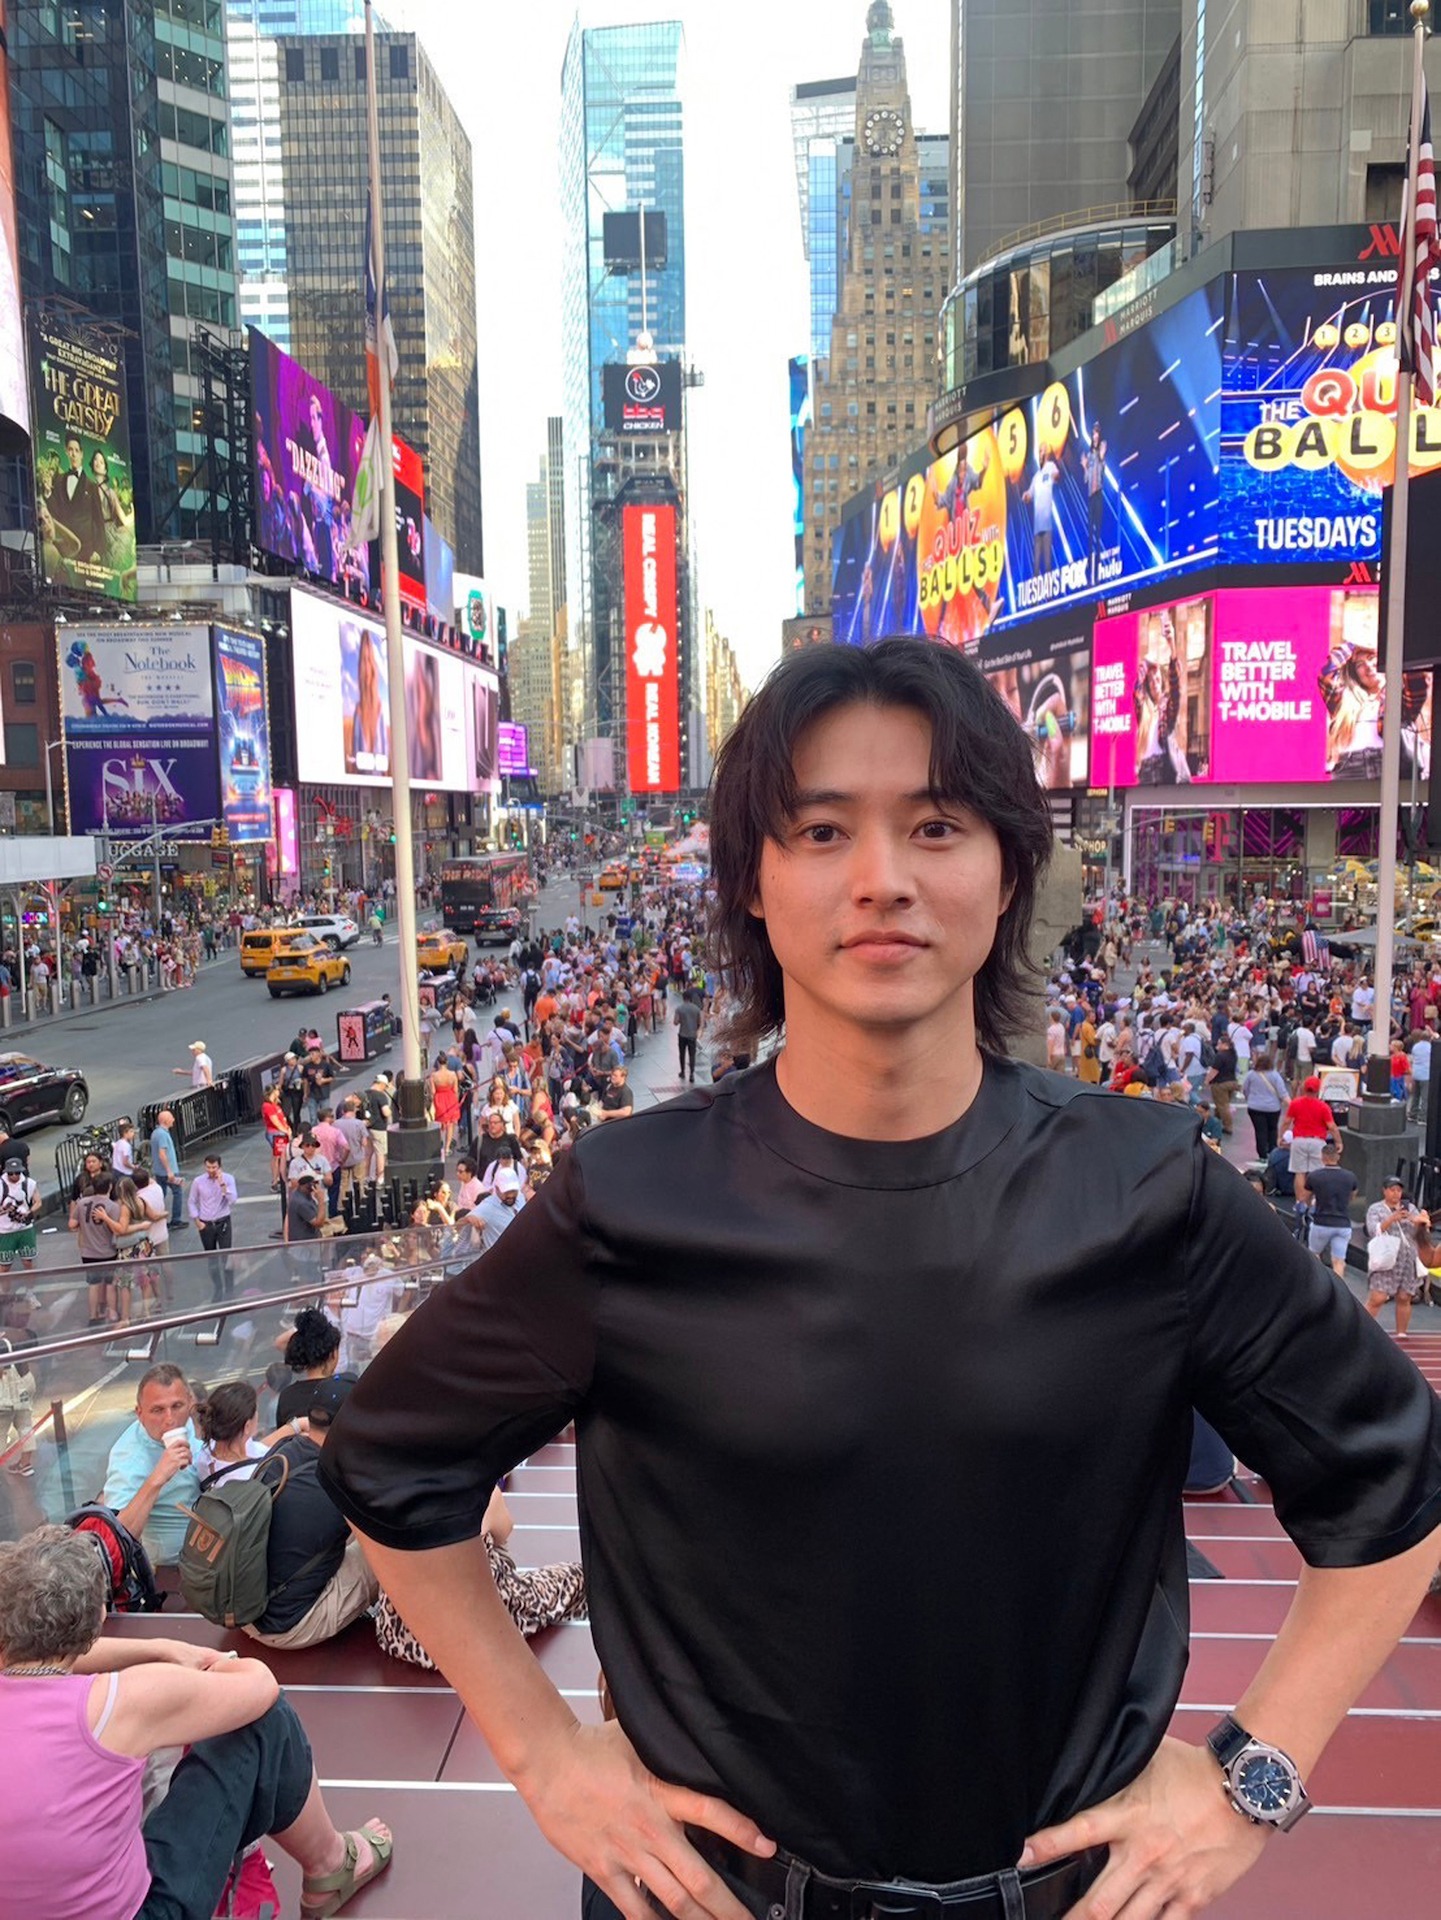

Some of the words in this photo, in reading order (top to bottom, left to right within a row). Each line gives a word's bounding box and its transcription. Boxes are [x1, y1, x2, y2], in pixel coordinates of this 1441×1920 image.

[1314, 271, 1365, 286] BRAINS
[1367, 269, 1398, 284] AND
[1120, 287, 1158, 321] MARRIOTT
[1119, 305, 1153, 335] MARQUIS
[43, 361, 70, 398] THE
[73, 379, 120, 416] GREAT
[54, 395, 114, 436] GATSBY
[1052, 395, 1061, 429] 6
[1259, 401, 1300, 421] THE
[623, 421, 663, 430] CHICKEN
[1009, 422, 1017, 455] 5
[910, 485, 917, 513] 2
[884, 503, 889, 529] 1
[933, 507, 981, 564] QUIZ
[1255, 514, 1377, 550] TUESDAYS
[920, 544, 998, 603] BALLS!
[1097, 558, 1122, 581] hulu
[1017, 568, 1060, 608] TUESDAYS
[1061, 557, 1088, 594] FOX
[123, 652, 196, 671] Notebook
[149, 646, 170, 655] The
[1221, 641, 1297, 662] TRAVEL
[1094, 662, 1125, 684] TRAVEL
[1221, 661, 1297, 682] BETTER
[1094, 680, 1125, 700] BETTER
[1220, 681, 1275, 701] WITH
[1094, 698, 1117, 717] WITH
[1219, 701, 1312, 721] T-MOBILE
[1093, 714, 1132, 734] T-MOBILE
[72, 740, 102, 749] EXPERIENCE
[103, 740, 113, 749] THE
[113, 740, 132, 749] GLOBAL
[133, 740, 159, 749] SENSATION
[160, 740, 171, 749] LIVE
[103, 757, 184, 804] SIX
[108, 844, 179, 857] UGGAGE
